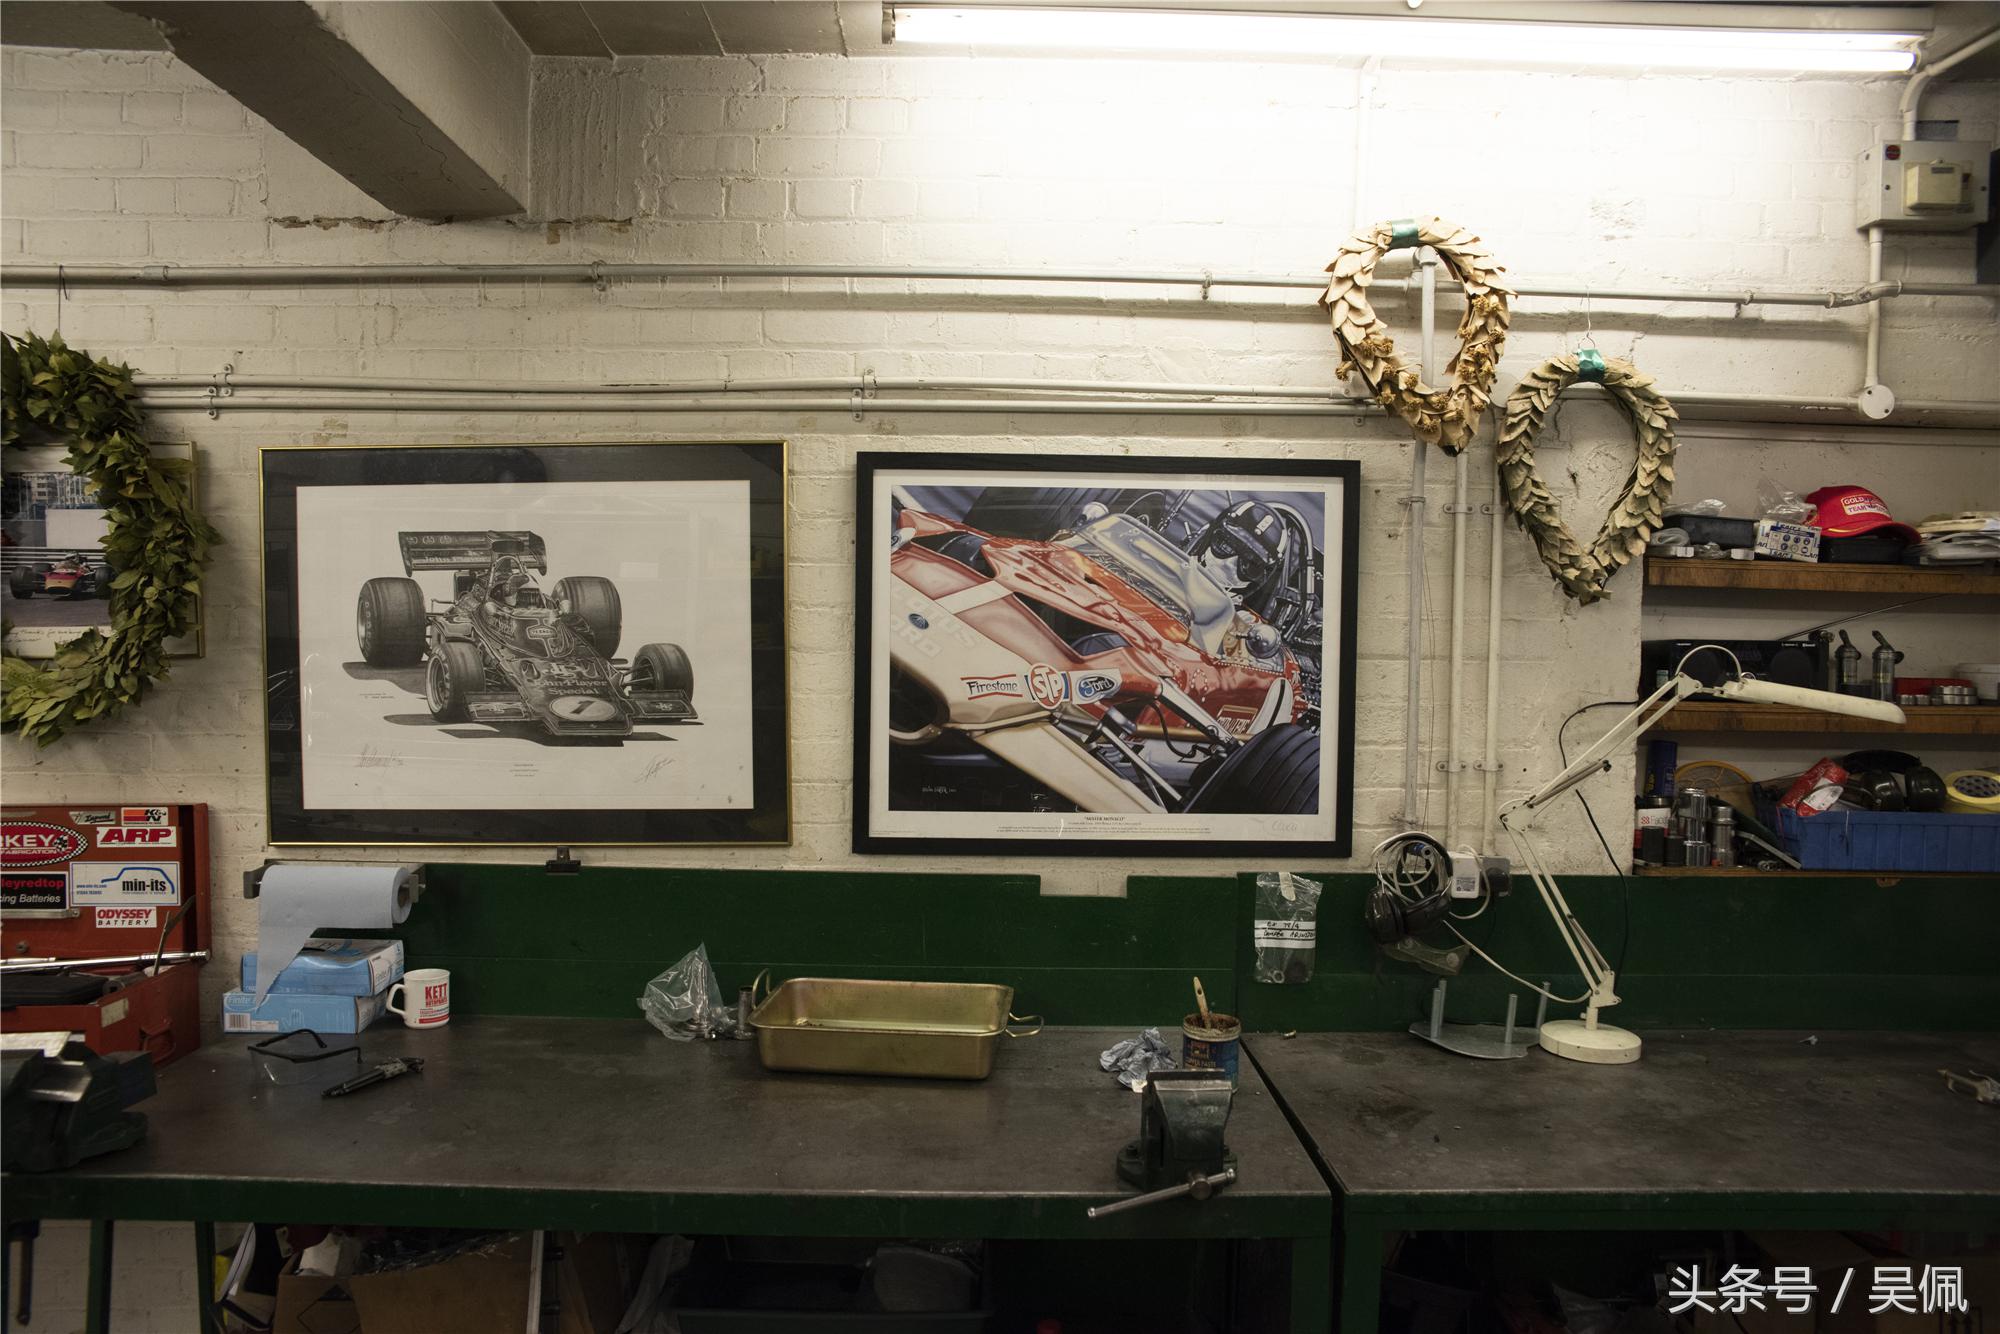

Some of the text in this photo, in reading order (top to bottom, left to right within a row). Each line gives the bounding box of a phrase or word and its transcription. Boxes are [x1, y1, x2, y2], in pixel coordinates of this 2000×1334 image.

[1843, 496, 1865, 505] GOLD
[966, 680, 1018, 695] Firestone
[1032, 666, 1064, 703] STP
[1081, 676, 1115, 696] Ford
[0, 834, 54, 847] KEY
[101, 828, 172, 842] ARP
[122, 878, 167, 892] min-its
[0, 893, 62, 905] ing Batteries
[97, 908, 152, 919] ODYSSEY
[424, 982, 448, 1000] KETT
